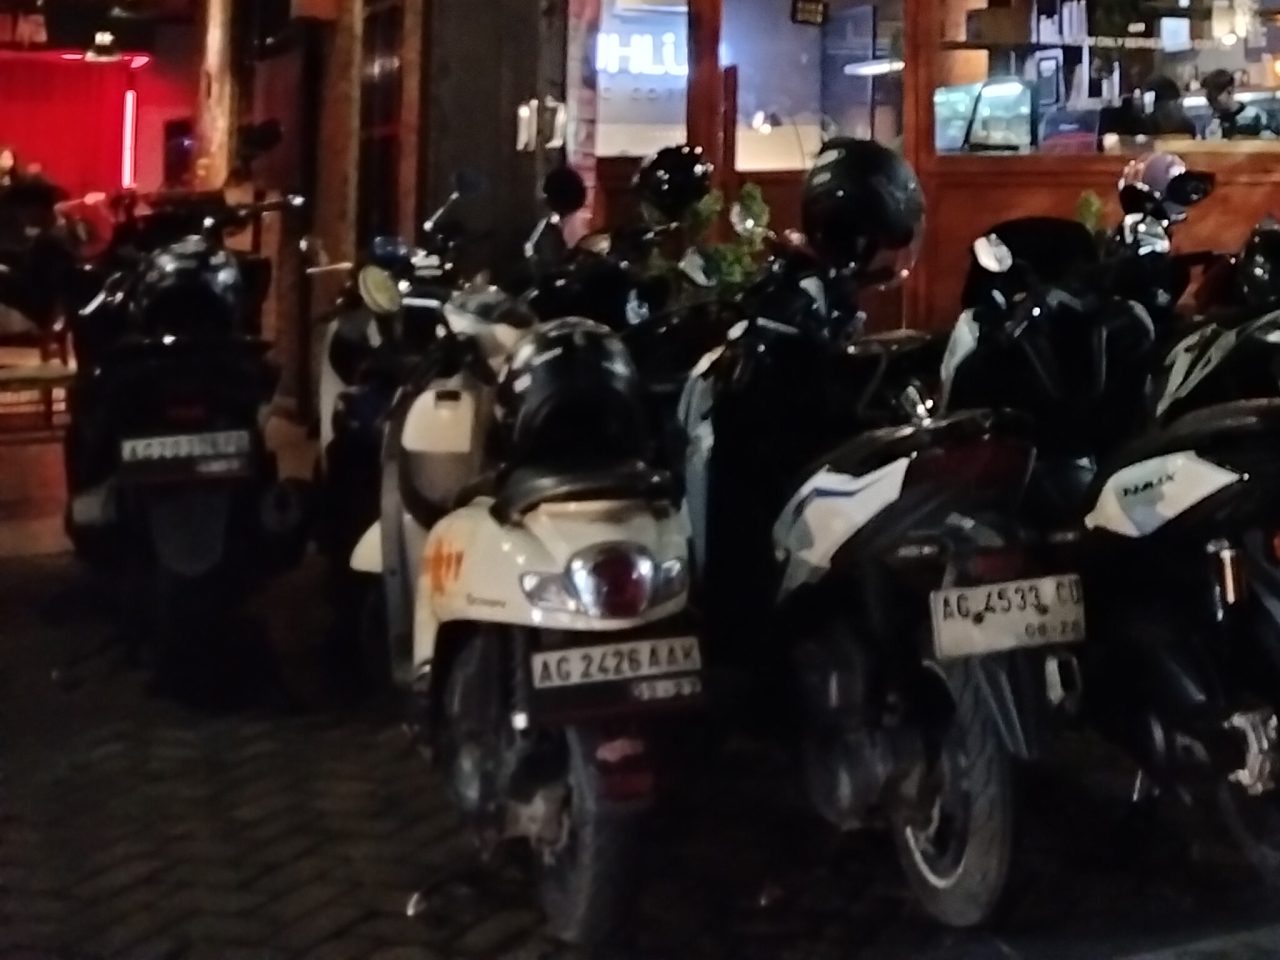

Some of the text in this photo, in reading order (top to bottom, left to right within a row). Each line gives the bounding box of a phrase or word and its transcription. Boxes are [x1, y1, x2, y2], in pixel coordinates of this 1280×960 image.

[943, 592, 971, 621] AG
[538, 655, 572, 685] AG
[580, 648, 642, 679] 2426
